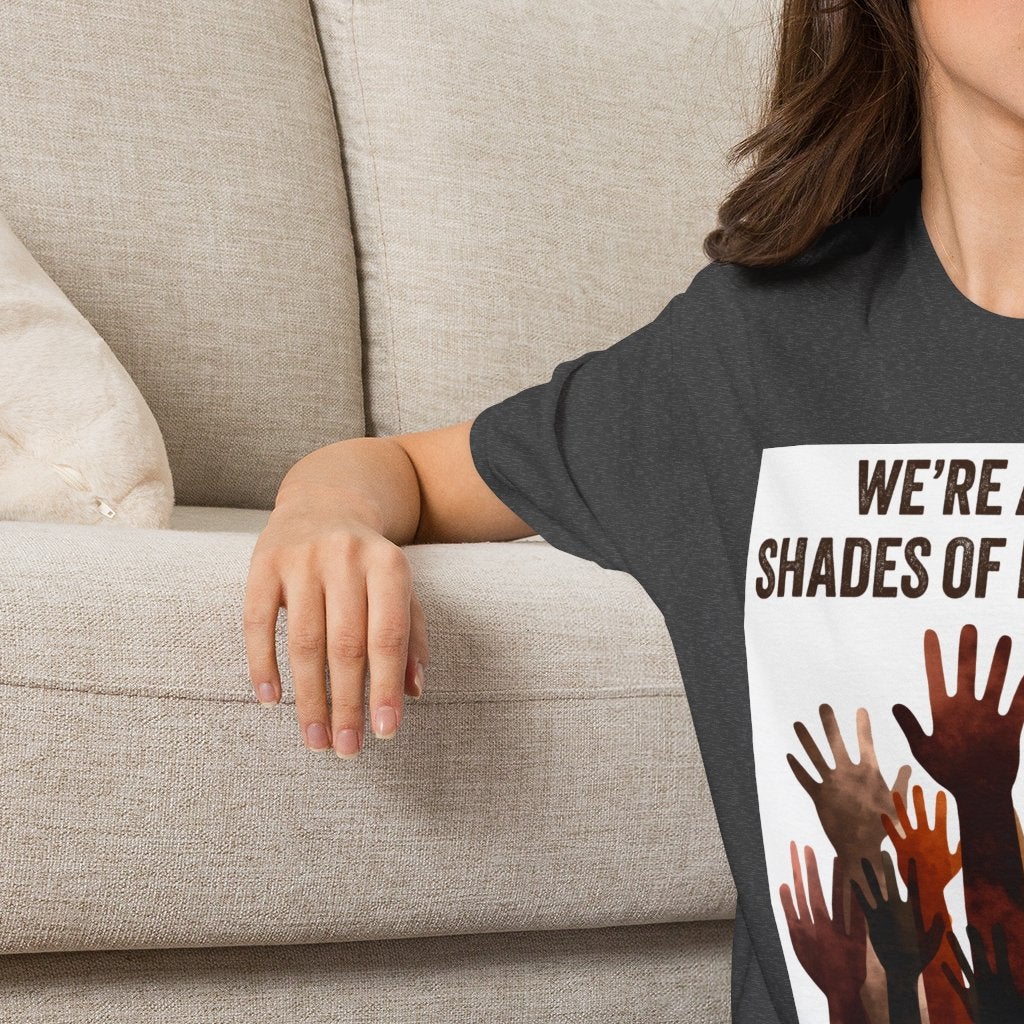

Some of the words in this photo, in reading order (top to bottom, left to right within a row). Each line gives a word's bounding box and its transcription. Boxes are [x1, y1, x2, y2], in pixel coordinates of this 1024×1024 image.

[858, 459, 1008, 516] WE’RE
[755, 537, 932, 600] SHADES
[942, 536, 1007, 599] OF
